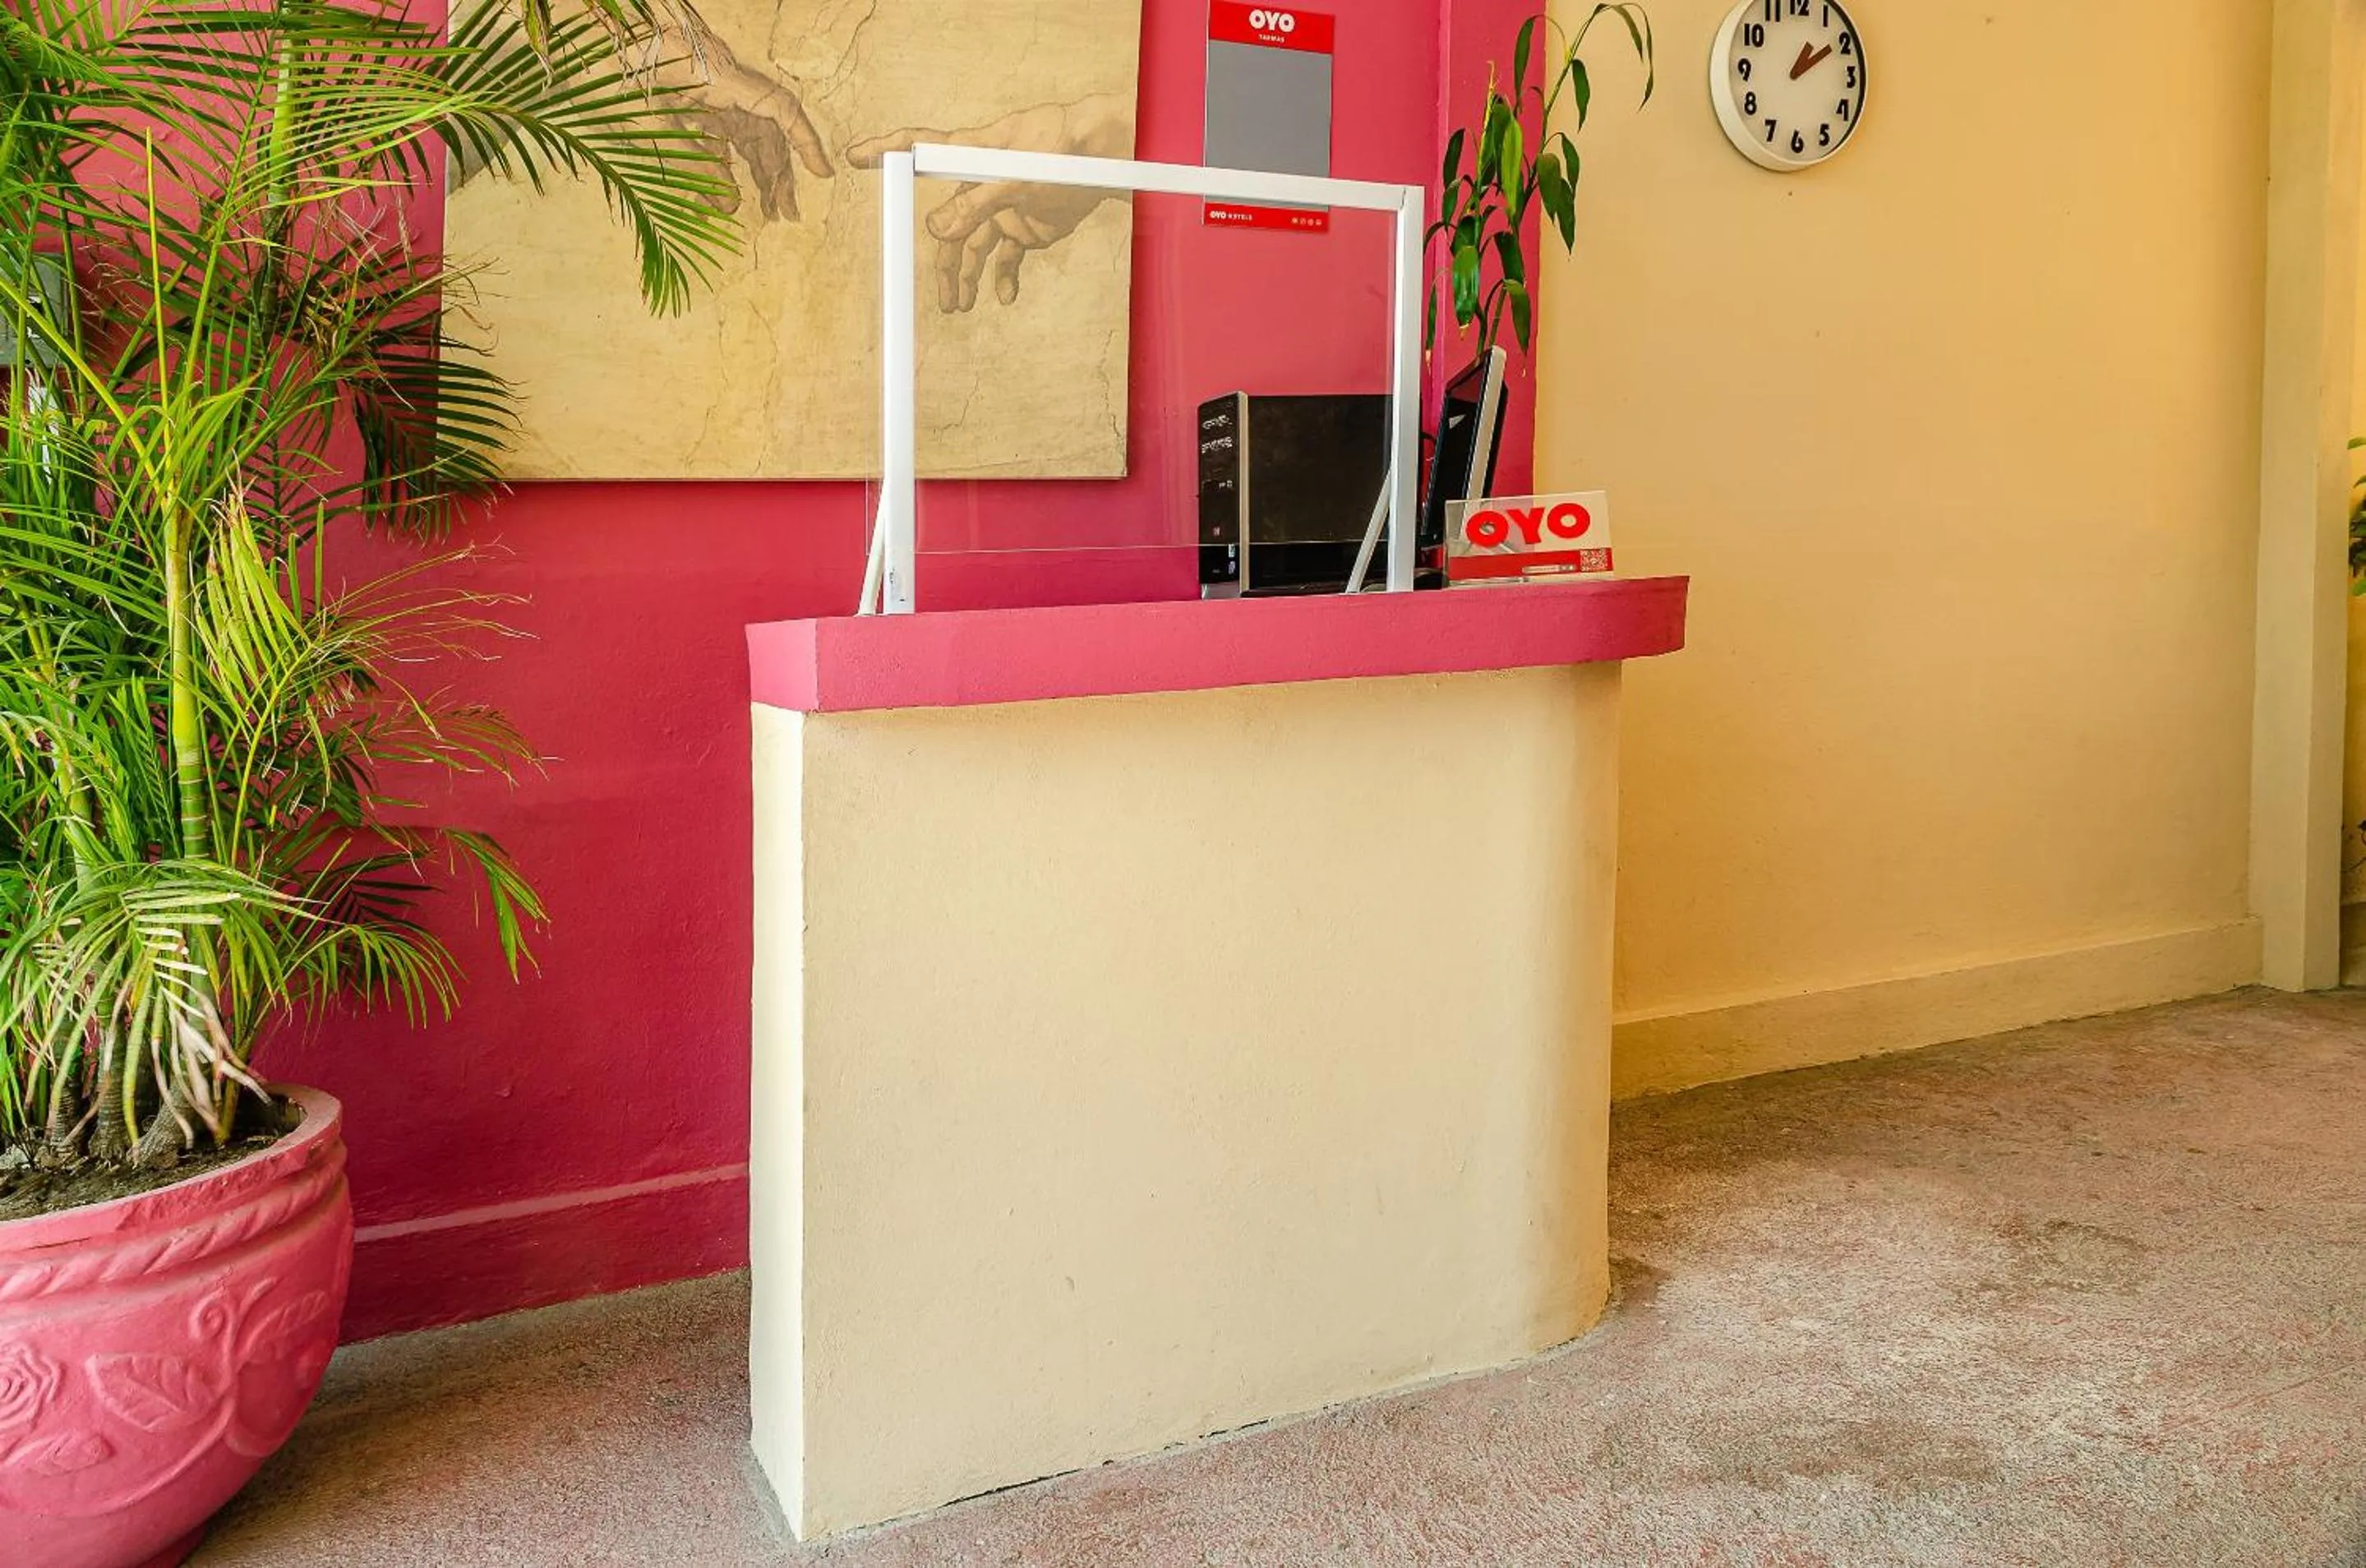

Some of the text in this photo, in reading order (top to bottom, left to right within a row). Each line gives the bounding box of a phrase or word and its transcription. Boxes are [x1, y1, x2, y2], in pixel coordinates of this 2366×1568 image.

[1765, 0, 1781, 22] 11
[1790, 0, 1810, 16] 12
[1823, 5, 1829, 27] 1
[1249, 9, 1295, 33] OYO
[1744, 23, 1764, 47] 10
[1838, 32, 1851, 54] 2
[1737, 58, 1751, 81] 9
[1847, 66, 1856, 88] 3
[1744, 91, 1757, 115] 8
[1836, 99, 1848, 121] 4
[1765, 119, 1777, 141] 7
[1819, 124, 1829, 145] 5
[1791, 130, 1804, 153] 6
[1210, 210, 1226, 219] OYO
[1465, 503, 1591, 548] OYO
